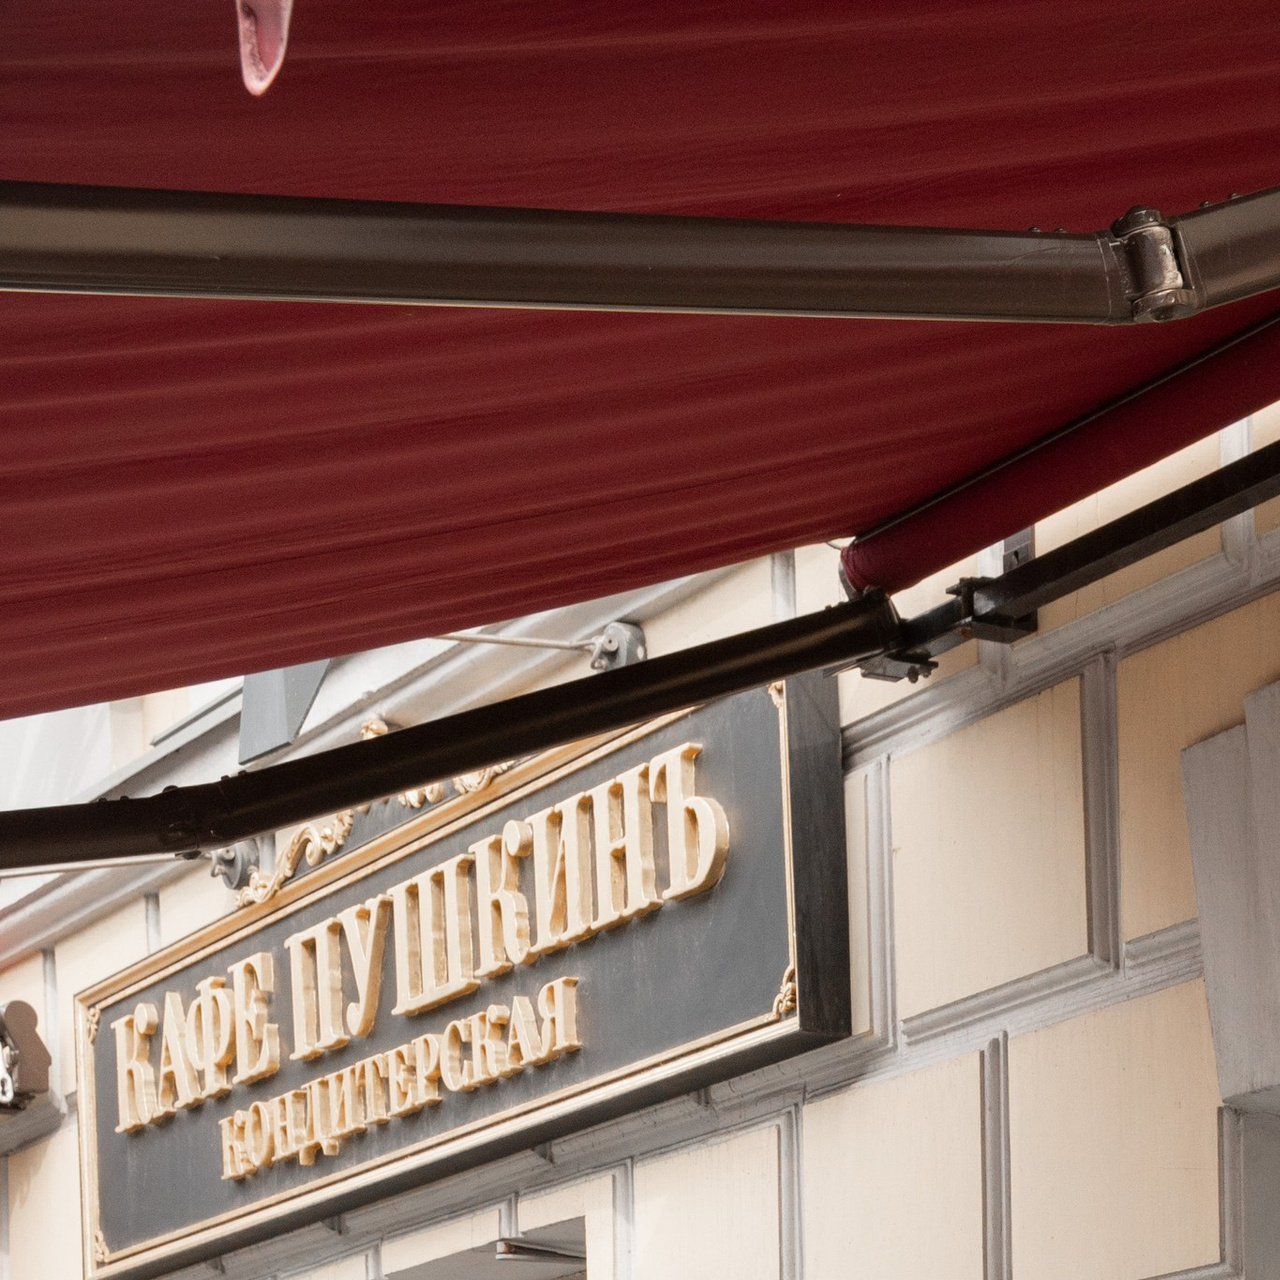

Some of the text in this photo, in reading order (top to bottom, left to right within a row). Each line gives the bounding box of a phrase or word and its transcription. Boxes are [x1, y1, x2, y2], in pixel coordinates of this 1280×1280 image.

[111, 742, 731, 1134] КАФЕ ПУШКИНЪ
[219, 976, 580, 1181] КОНДИТЕРСКАЯ
